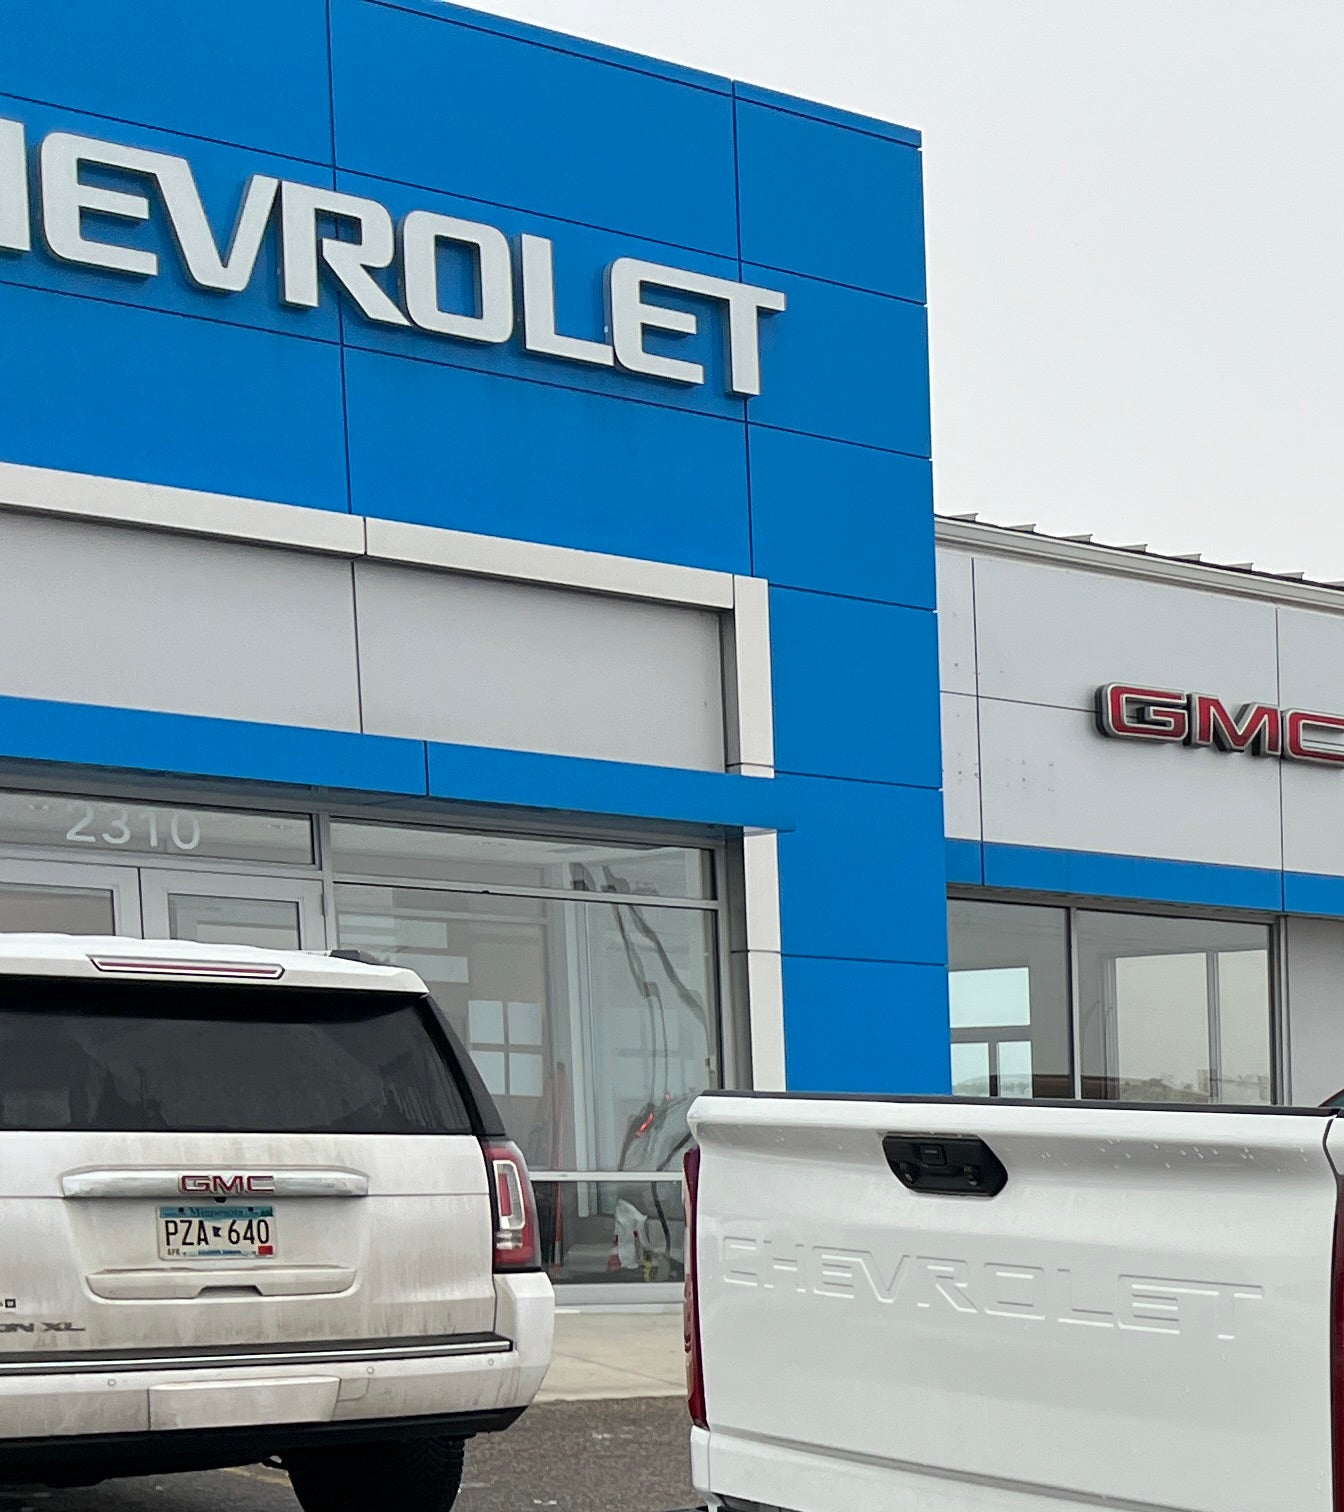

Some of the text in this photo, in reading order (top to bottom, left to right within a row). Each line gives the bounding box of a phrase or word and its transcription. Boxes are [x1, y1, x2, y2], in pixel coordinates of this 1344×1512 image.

[66, 804, 200, 849] 2310
[179, 1175, 275, 1192] GMC
[164, 1219, 269, 1246] PZA 640
[721, 1235, 1263, 1341] CHEVROLET
[40, 1321, 86, 1332] XL
